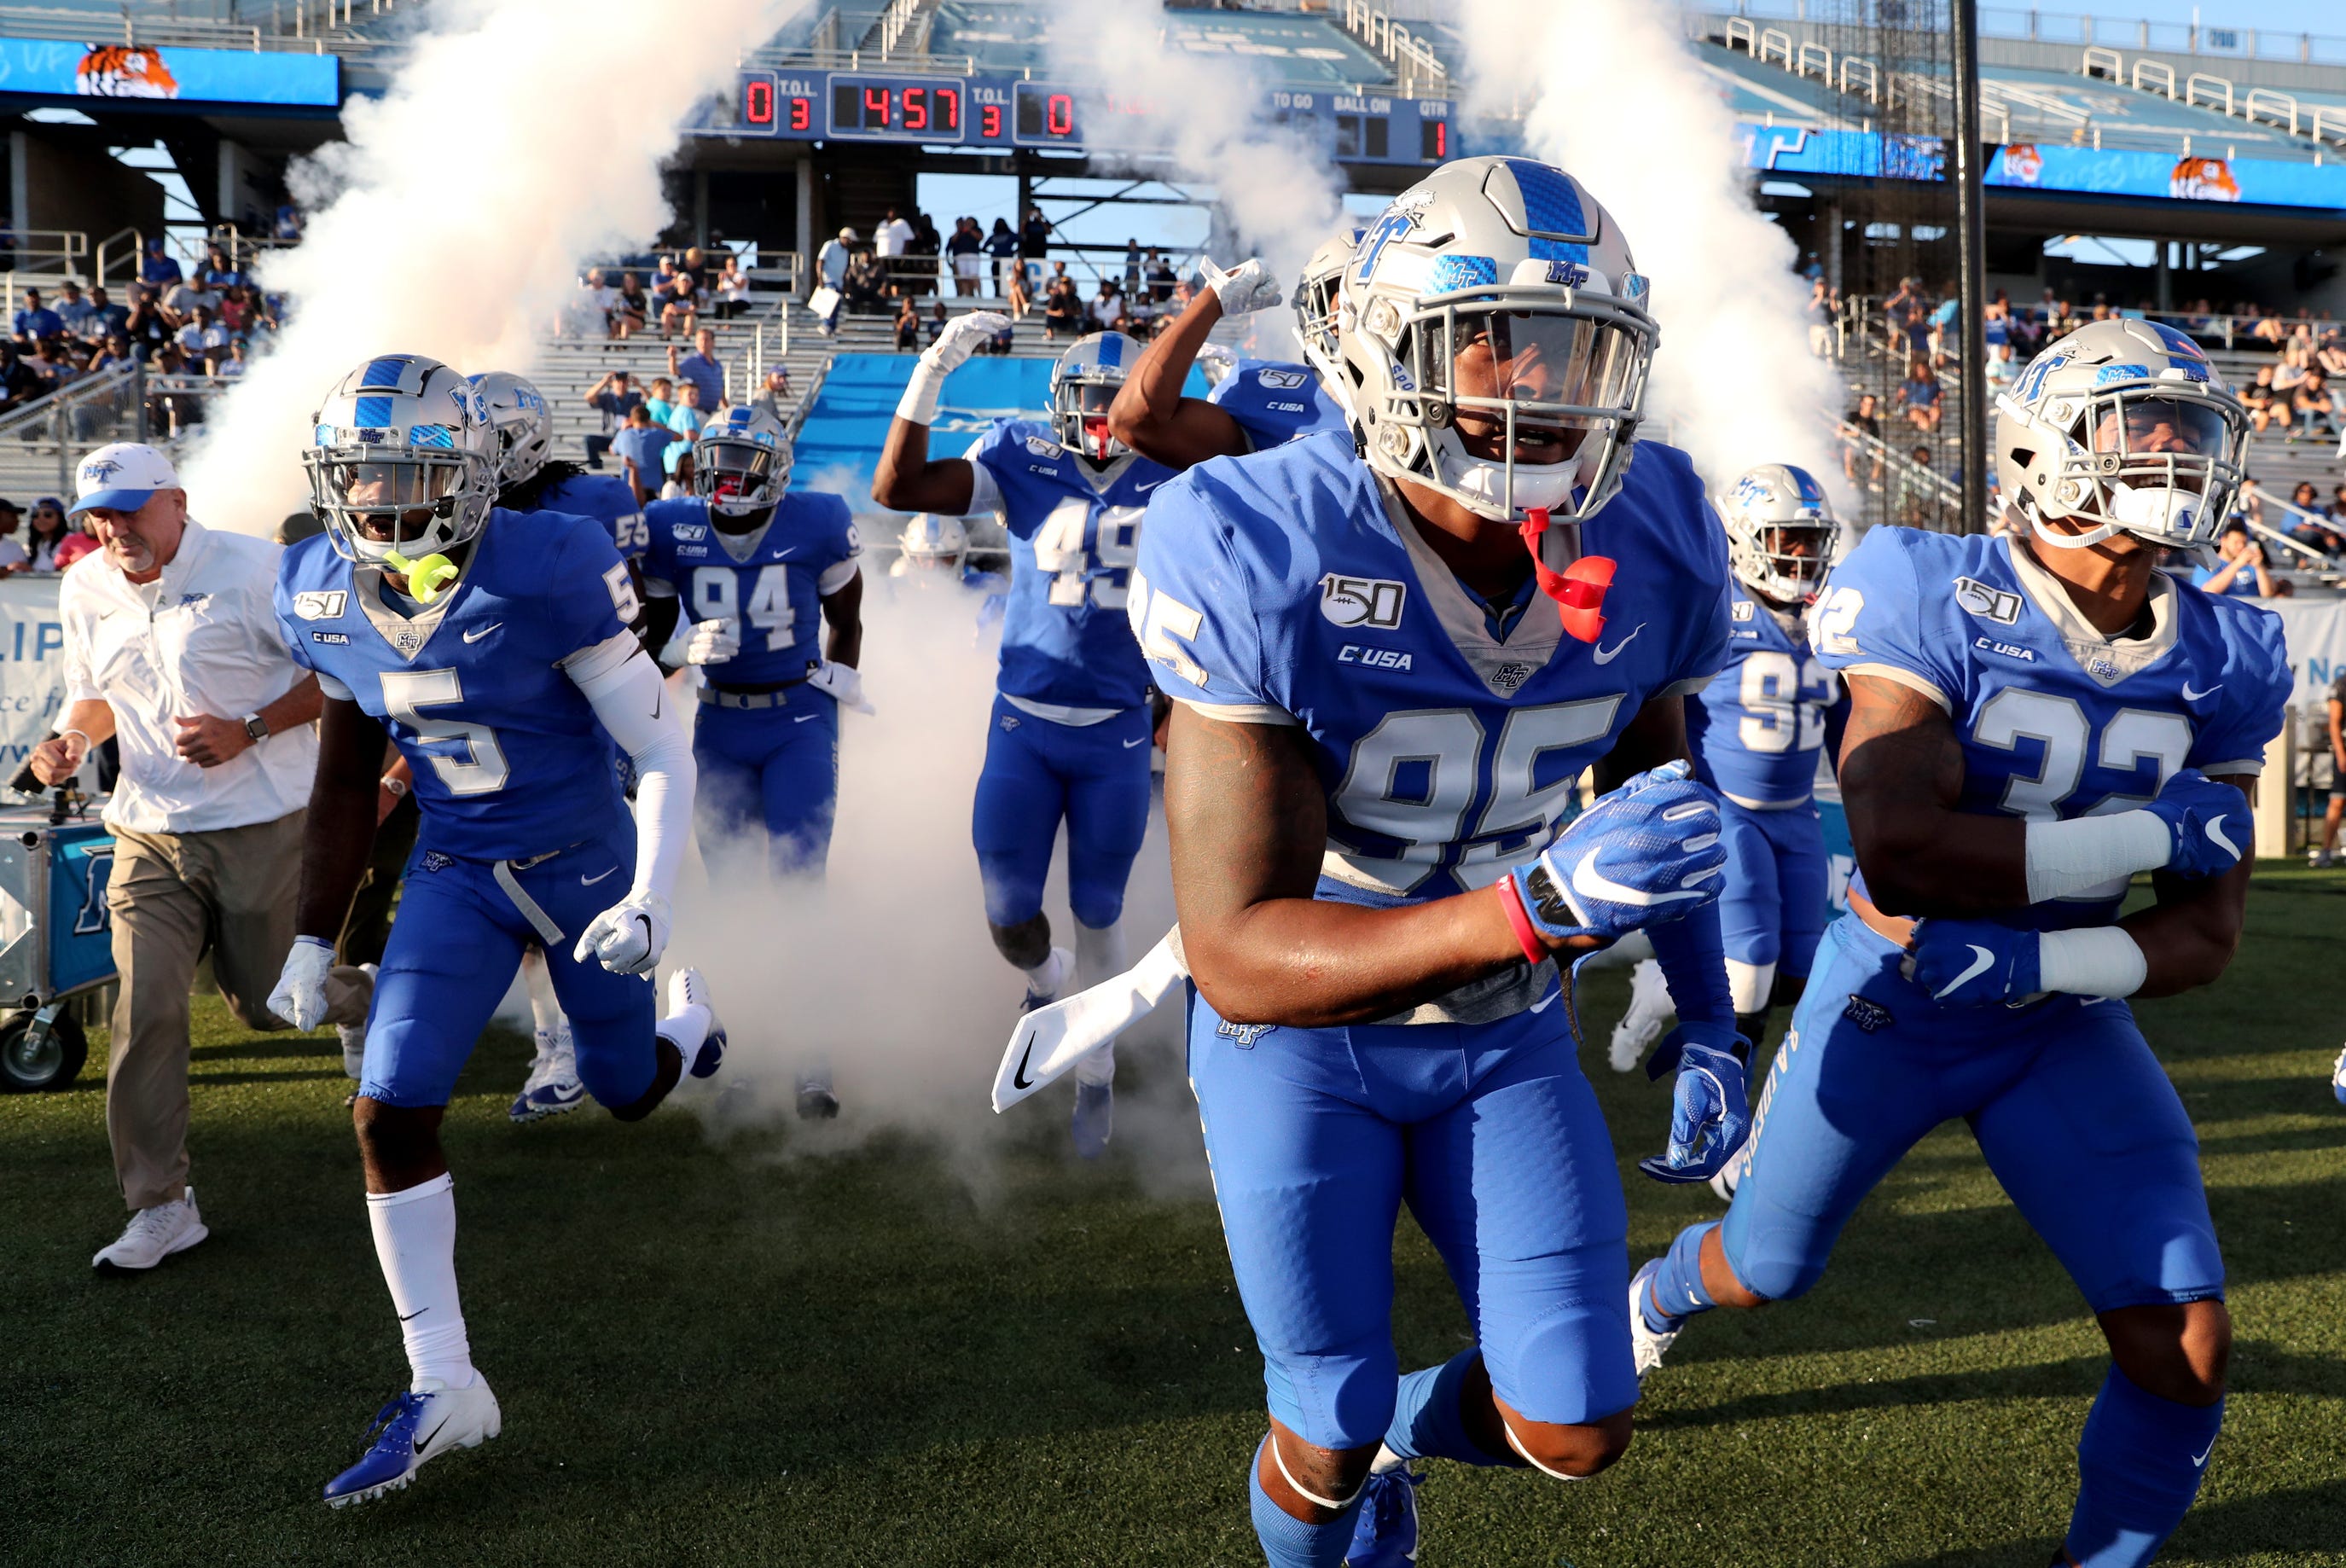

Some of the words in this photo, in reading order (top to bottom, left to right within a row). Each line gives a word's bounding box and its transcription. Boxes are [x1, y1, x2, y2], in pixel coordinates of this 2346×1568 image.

[747, 82, 772, 123] 0
[779, 80, 817, 97] T.O.L.
[973, 88, 1010, 104] T.O.L.
[1273, 93, 1290, 107] TO
[1292, 94, 1313, 109] GO
[1333, 96, 1368, 113] BALL
[1370, 98, 1391, 113] ON
[791, 98, 810, 130] 3
[865, 89, 957, 128] 4:57
[983, 105, 1001, 137] 3
[1048, 95, 1072, 134] 0
[1420, 101, 1448, 117] QTR
[1437, 122, 1445, 157] 1
[1441, 263, 1477, 288] MT
[1547, 260, 1588, 290] MT
[357, 428, 385, 444] MT
[1033, 496, 1147, 609] 49
[601, 560, 640, 624] 5
[694, 564, 795, 652] 94
[1326, 577, 1404, 625] 150
[1960, 578, 2020, 623] 150
[0, 622, 63, 661] IP
[324, 635, 348, 644] USA
[1975, 637, 1989, 649] C
[1994, 643, 2035, 662] USA
[1338, 646, 1361, 662] C
[1362, 653, 1413, 671] USA
[2092, 659, 2119, 679] MT
[1491, 665, 1530, 688] MT
[1739, 651, 1839, 752] 92
[379, 666, 510, 796] 5
[1330, 693, 1627, 897] 95
[1972, 686, 2193, 901] 32
[1218, 1018, 1260, 1044] MT
